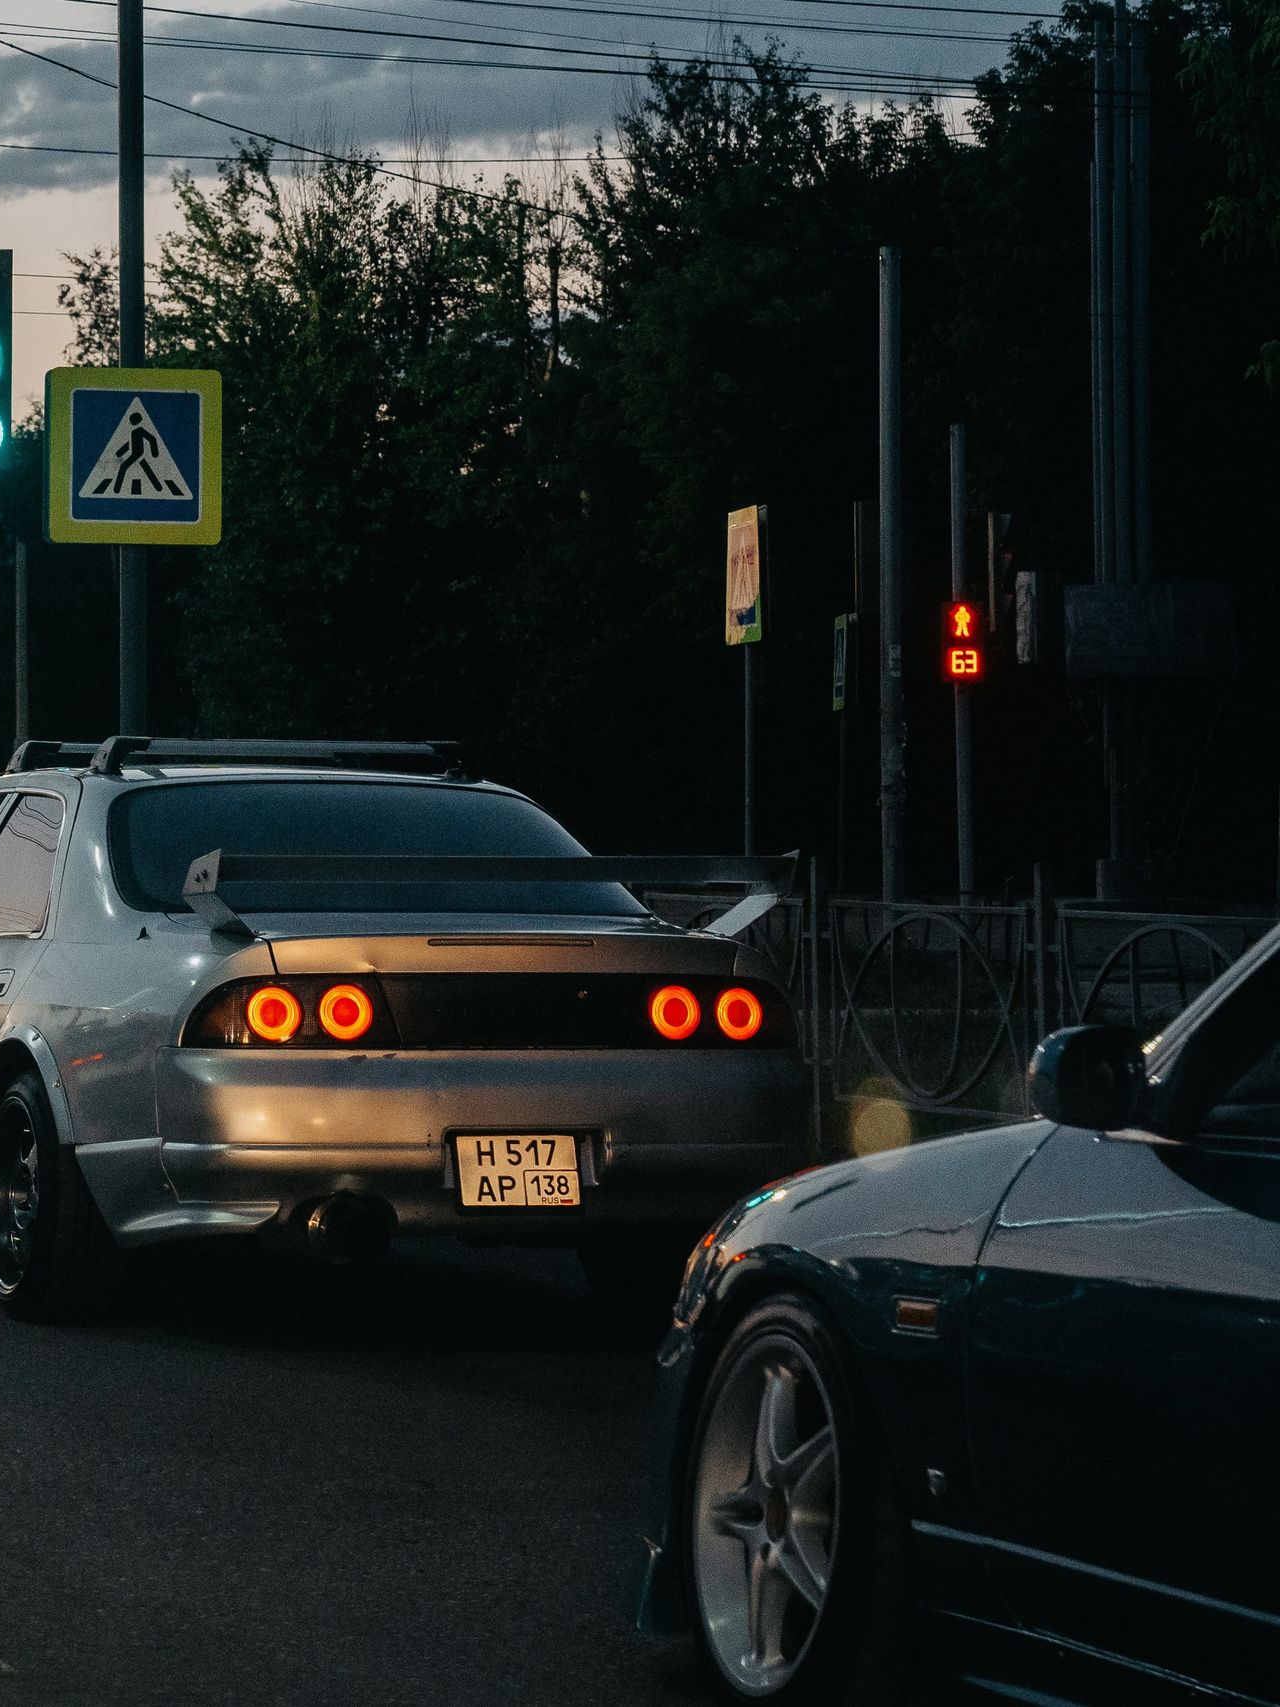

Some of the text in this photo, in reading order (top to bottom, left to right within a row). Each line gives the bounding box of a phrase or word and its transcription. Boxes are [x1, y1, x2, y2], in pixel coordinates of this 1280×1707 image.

[951, 650, 977, 673] 63
[505, 1139, 556, 1166] 517
[530, 1175, 570, 1196] 138
[541, 1196, 560, 1204] RUS
